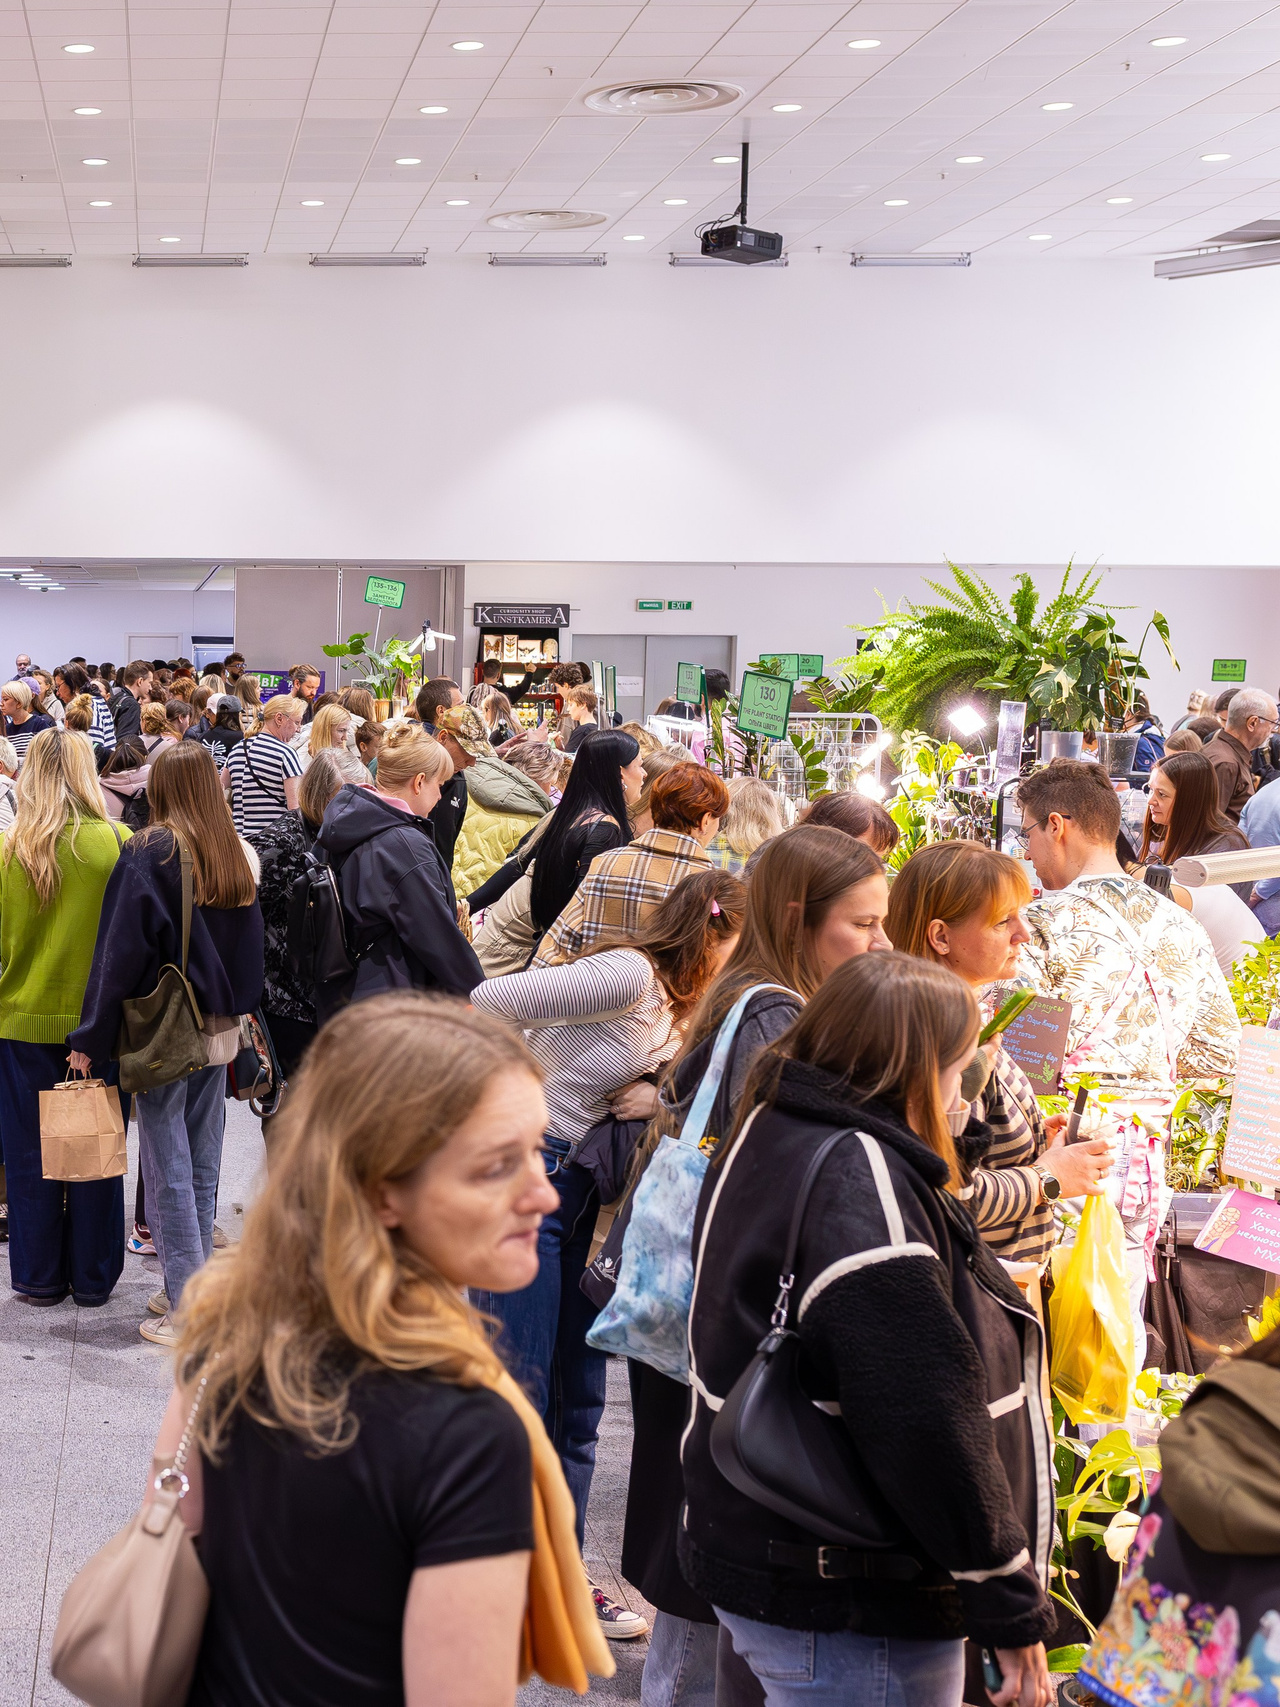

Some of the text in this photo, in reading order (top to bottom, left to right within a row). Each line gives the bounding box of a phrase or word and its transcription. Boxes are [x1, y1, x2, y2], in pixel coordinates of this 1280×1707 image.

[671, 601, 688, 609] EXIT
[475, 606, 568, 625] KUNSTKAMERA
[760, 686, 776, 702] 130
[751, 709, 765, 718] PLANT
[765, 712, 784, 723] STATION
